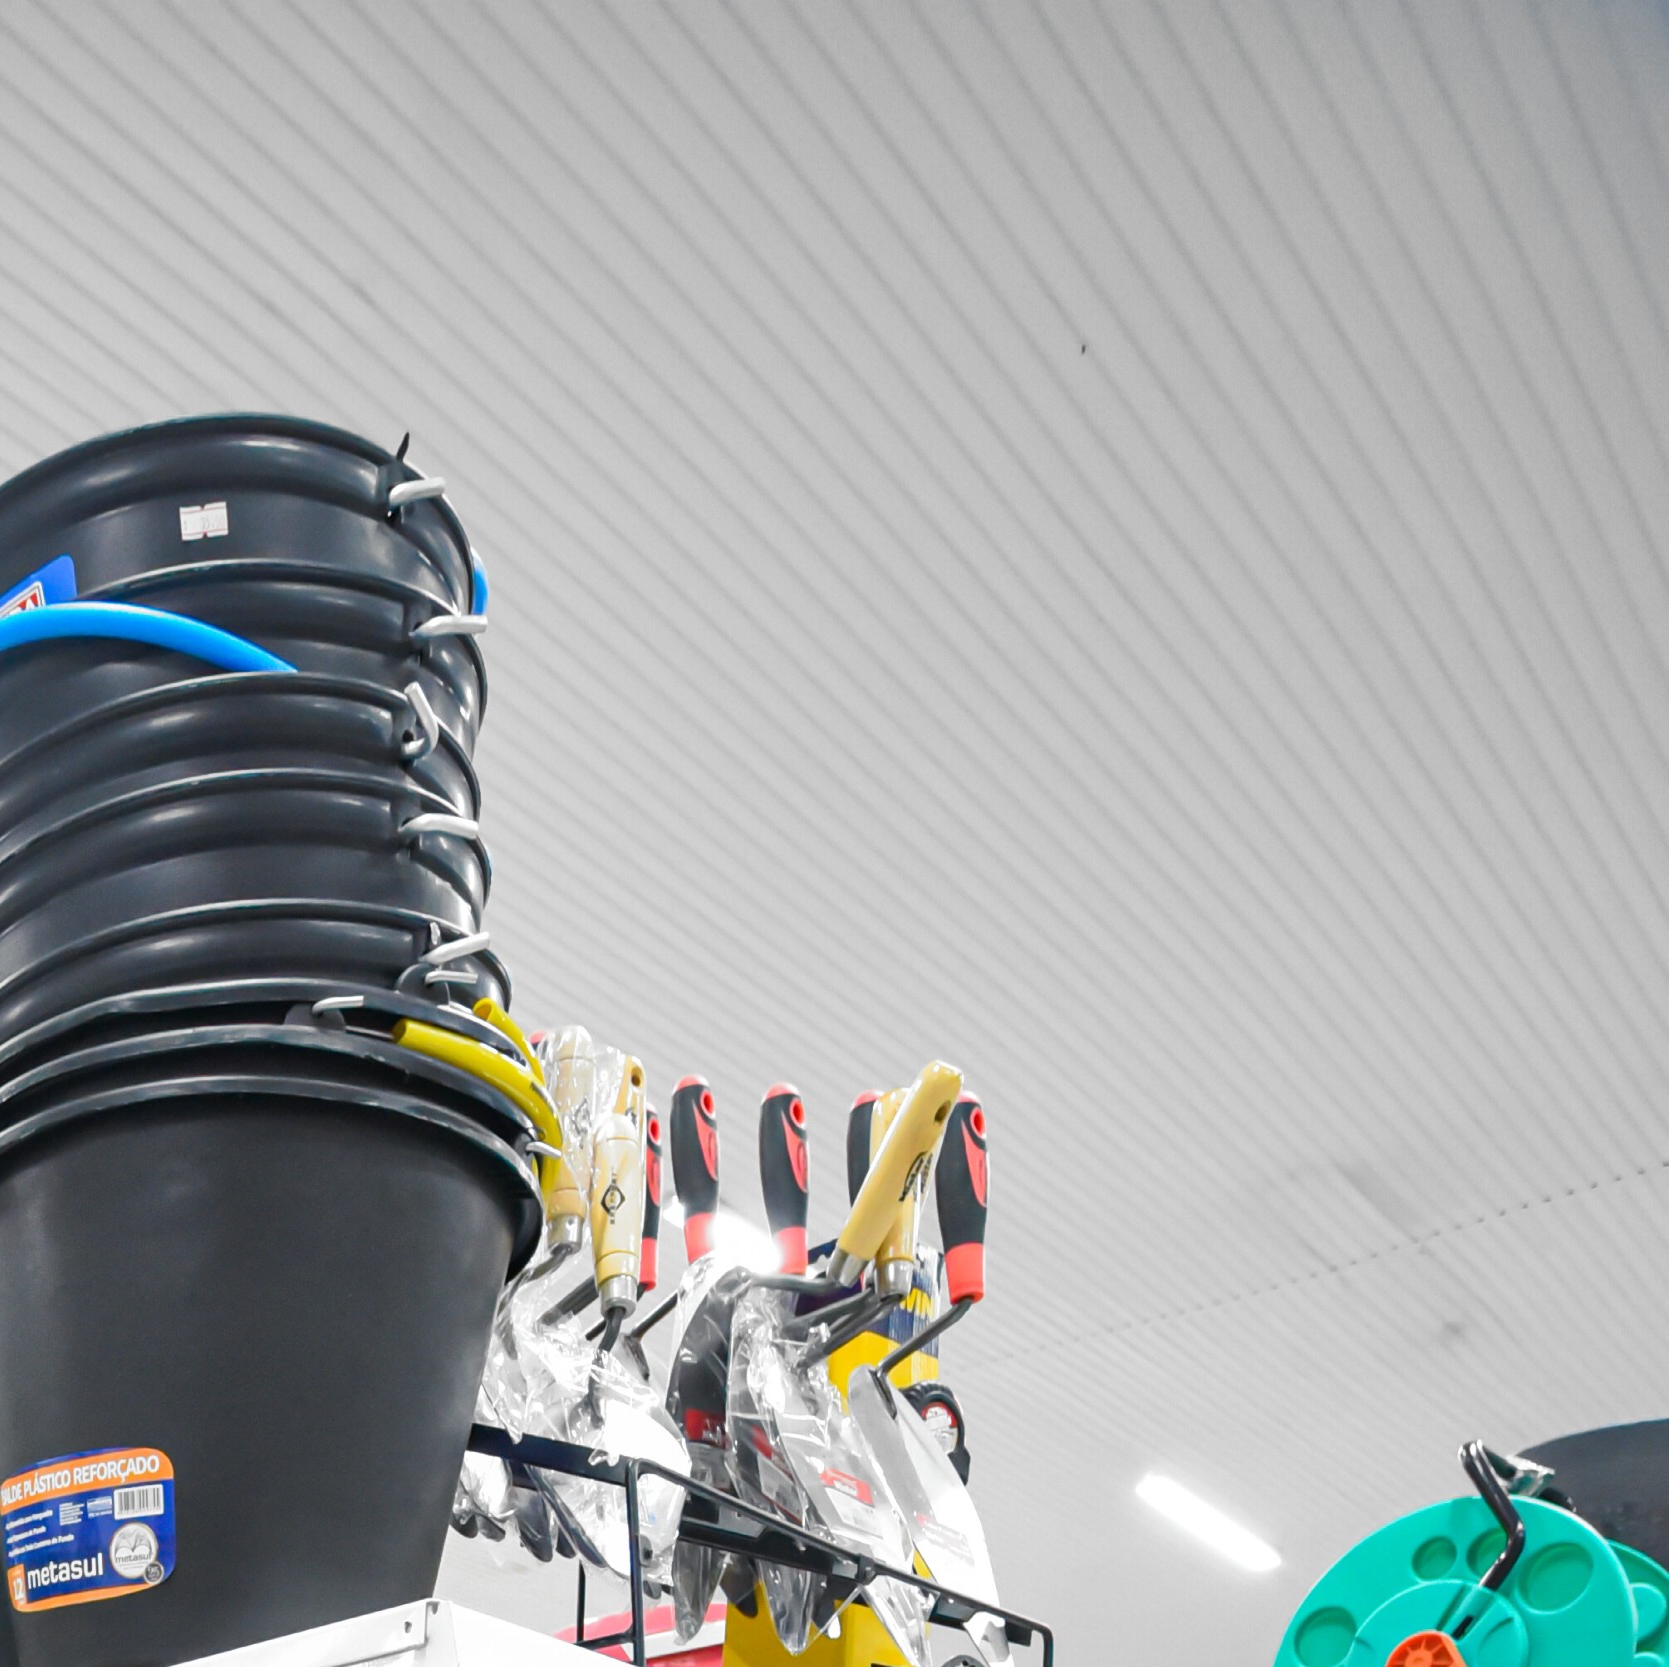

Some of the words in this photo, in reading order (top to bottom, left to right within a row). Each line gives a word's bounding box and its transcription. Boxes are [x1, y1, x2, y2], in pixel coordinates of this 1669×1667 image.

[23, 1469, 71, 1498] PLÁSTICO
[73, 1455, 160, 1485] REFORÇADO
[27, 1552, 104, 1590] metasul
